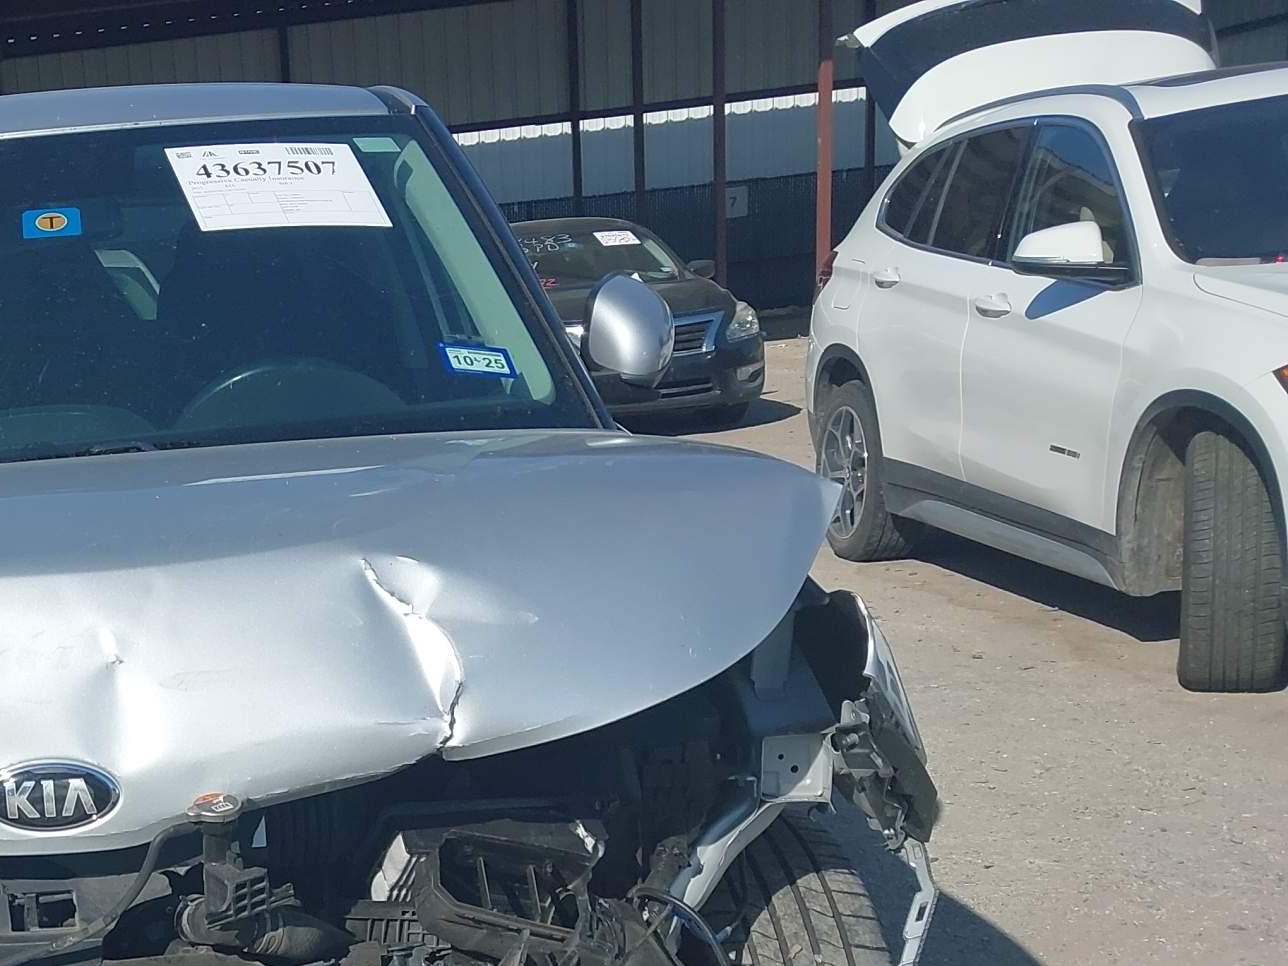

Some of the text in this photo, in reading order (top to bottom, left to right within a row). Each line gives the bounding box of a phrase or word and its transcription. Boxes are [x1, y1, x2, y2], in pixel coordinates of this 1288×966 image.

[195, 159, 337, 179] 43637507
[728, 196, 737, 209] 7
[41, 216, 62, 229] T
[3, 777, 98, 820] KIA
